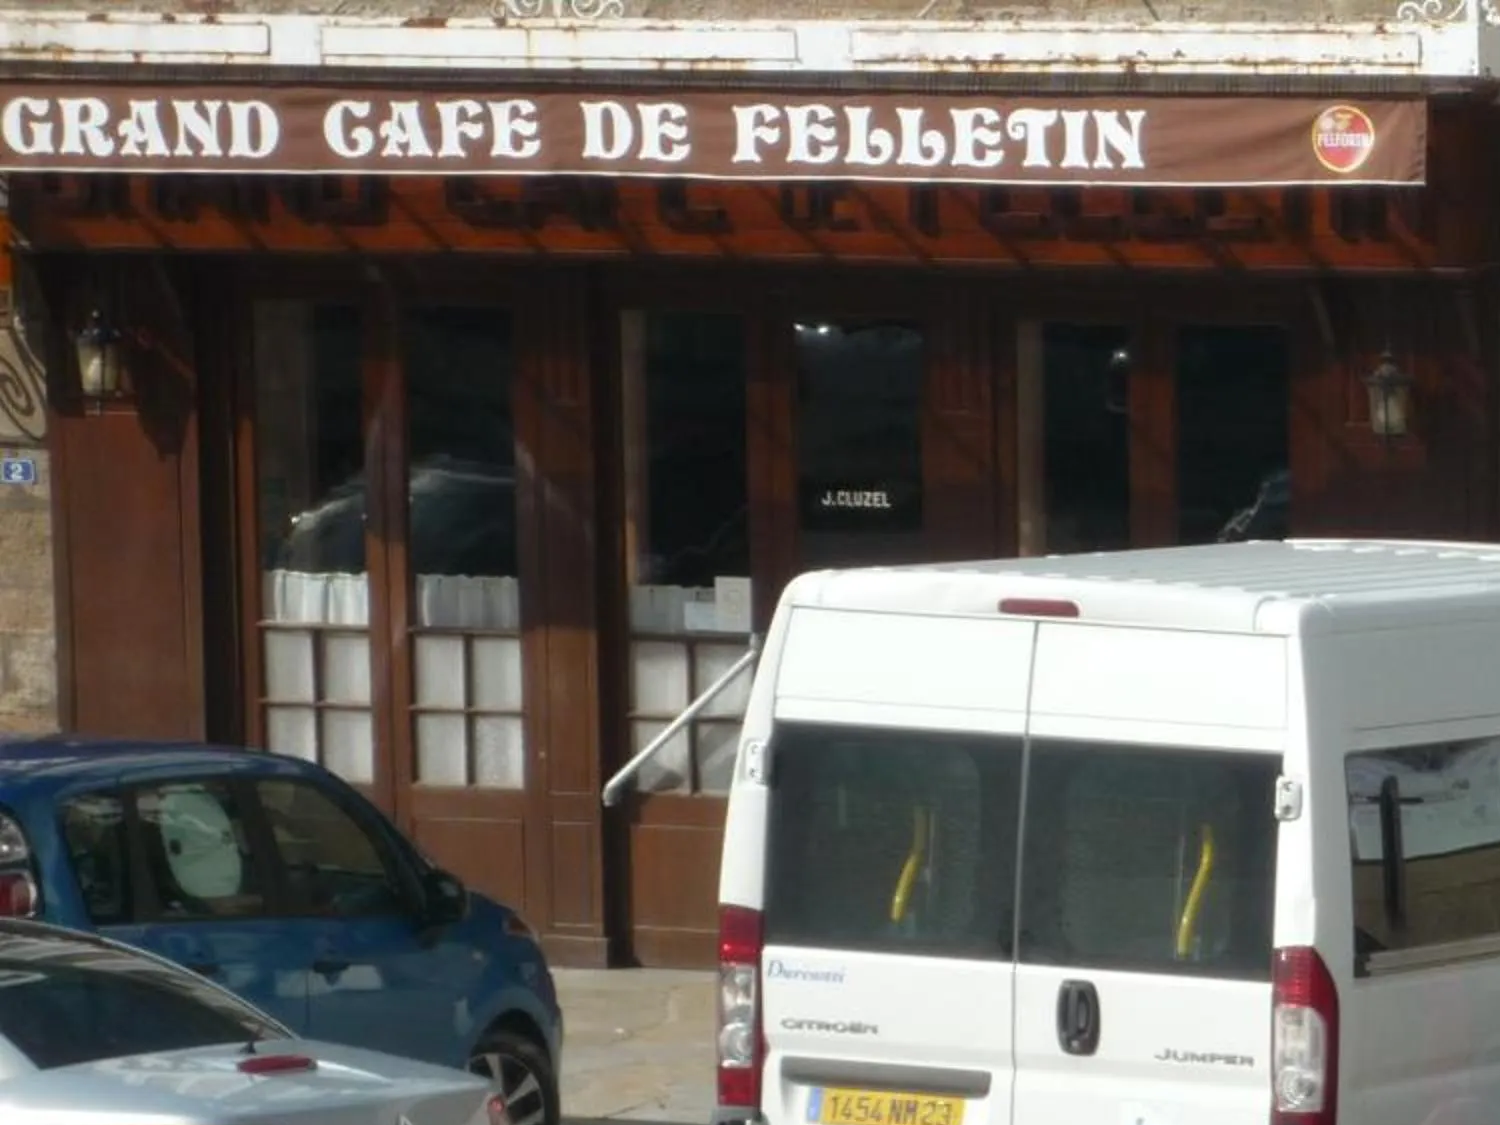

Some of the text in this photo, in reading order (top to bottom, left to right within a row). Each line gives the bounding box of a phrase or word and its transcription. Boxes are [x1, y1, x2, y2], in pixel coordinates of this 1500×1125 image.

[2, 97, 1147, 169] GRAND CAFE DE FELLETIN
[10, 462, 24, 480] 2
[1154, 1048, 1254, 1067] JUMPER
